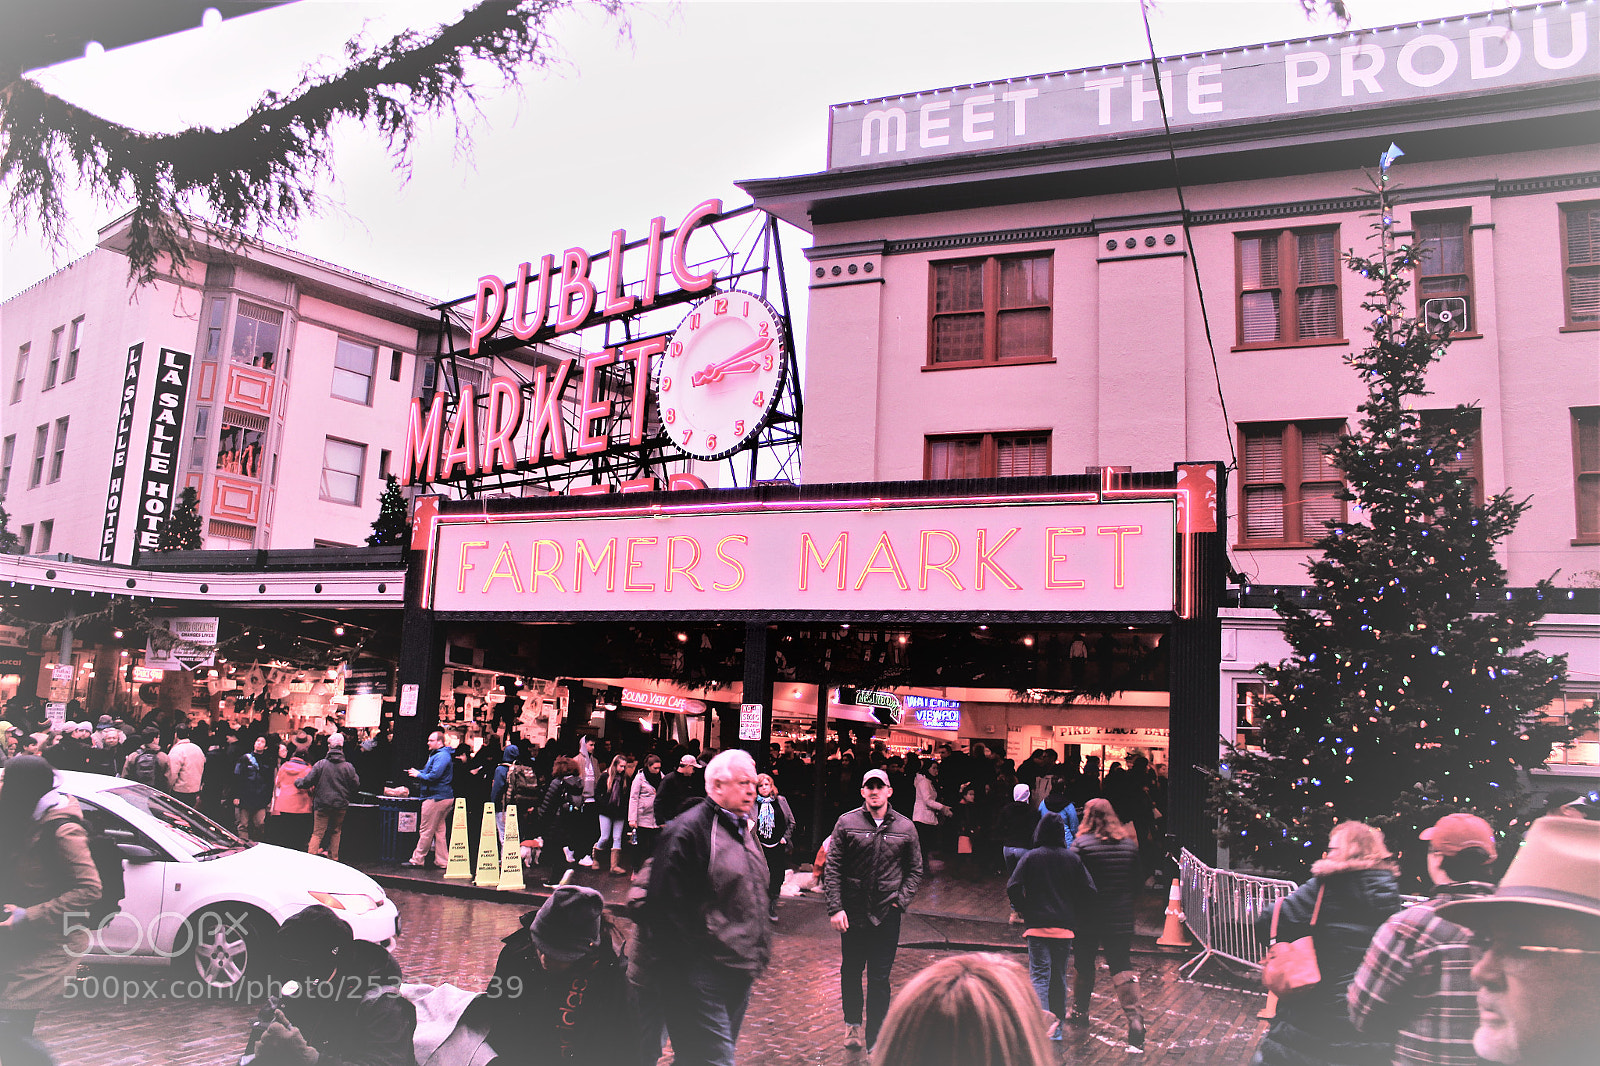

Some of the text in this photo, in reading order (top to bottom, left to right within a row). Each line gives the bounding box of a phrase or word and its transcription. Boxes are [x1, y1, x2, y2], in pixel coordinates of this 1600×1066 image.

[860, 11, 1588, 157] MEET THE PRODU
[469, 198, 723, 355] PUBLIC
[714, 298, 728, 314] 12
[743, 300, 749, 317] 1
[690, 313, 701, 330] 11
[759, 321, 769, 336] 2
[670, 342, 684, 357] 10
[763, 355, 773, 371] 3
[662, 376, 671, 391] 9
[753, 391, 764, 407] 4
[402, 335, 666, 486] MARKET
[665, 409, 676, 424] 8
[734, 420, 745, 437] 5
[682, 430, 693, 446] 7
[706, 434, 717, 450] 6
[101, 349, 139, 562] LA SALLE HOTEL
[138, 351, 183, 552] LA SALLE HOTE
[456, 524, 1144, 595] FARMERS MARKET
[621, 688, 648, 703] SOUND
[649, 693, 667, 706] VIEW
[1060, 727, 1090, 736] PIKE
[1097, 727, 1138, 735] PLACE
